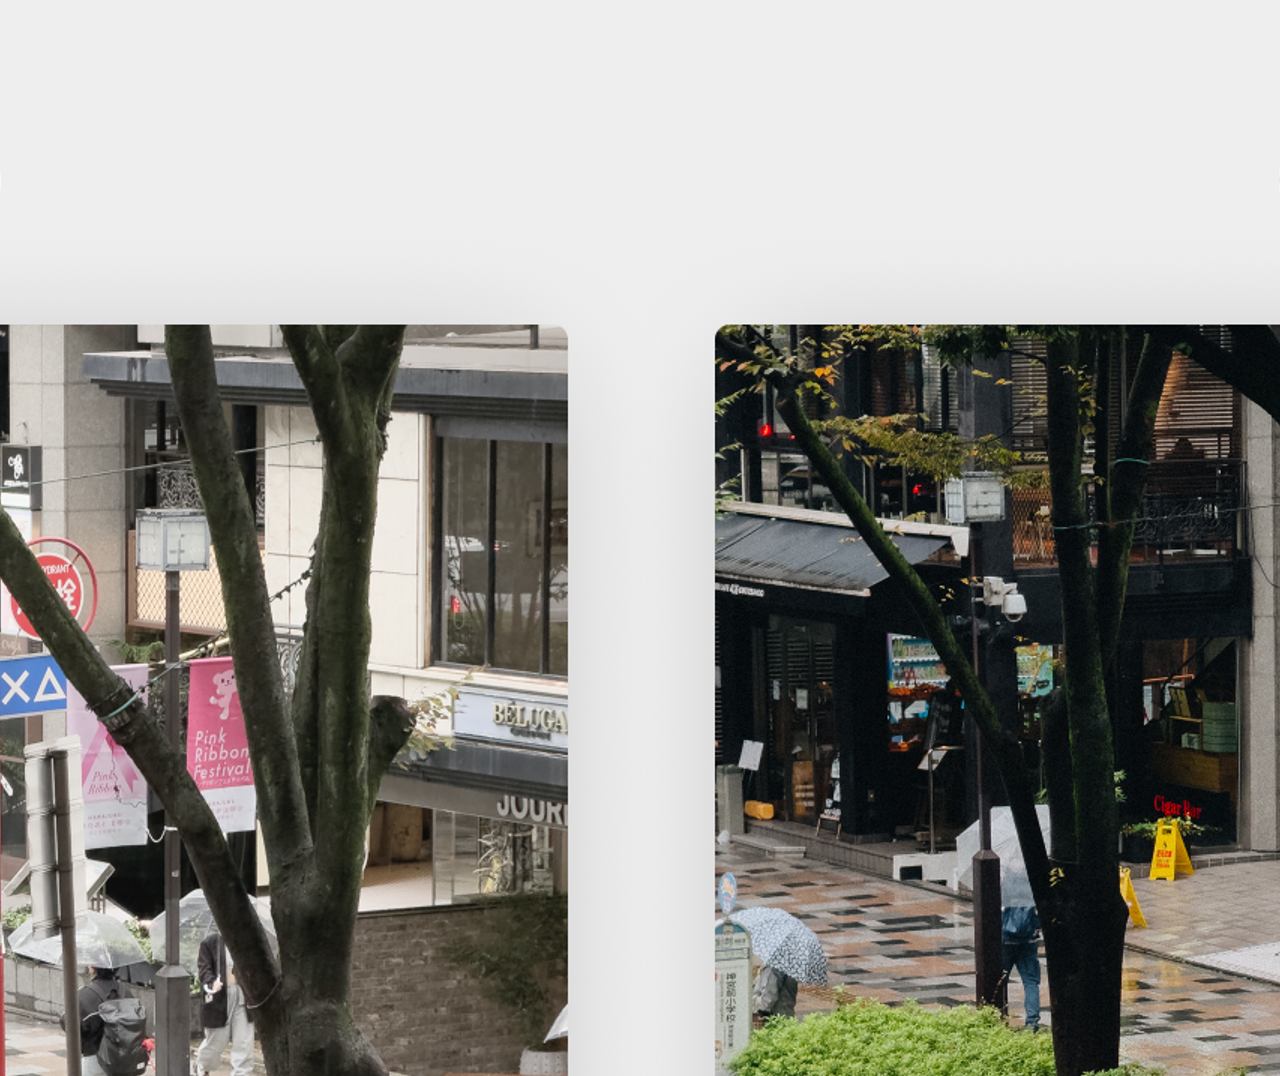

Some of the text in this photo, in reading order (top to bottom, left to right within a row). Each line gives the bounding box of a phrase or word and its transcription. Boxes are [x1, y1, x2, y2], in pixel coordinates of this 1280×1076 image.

[42, 564, 69, 575] YDRANT
[195, 727, 226, 746] Pink
[194, 747, 249, 764] Ribbon
[193, 758, 251, 780] Festival
[496, 794, 568, 826] JOUR
[1153, 794, 1202, 819] Cigar Bar
